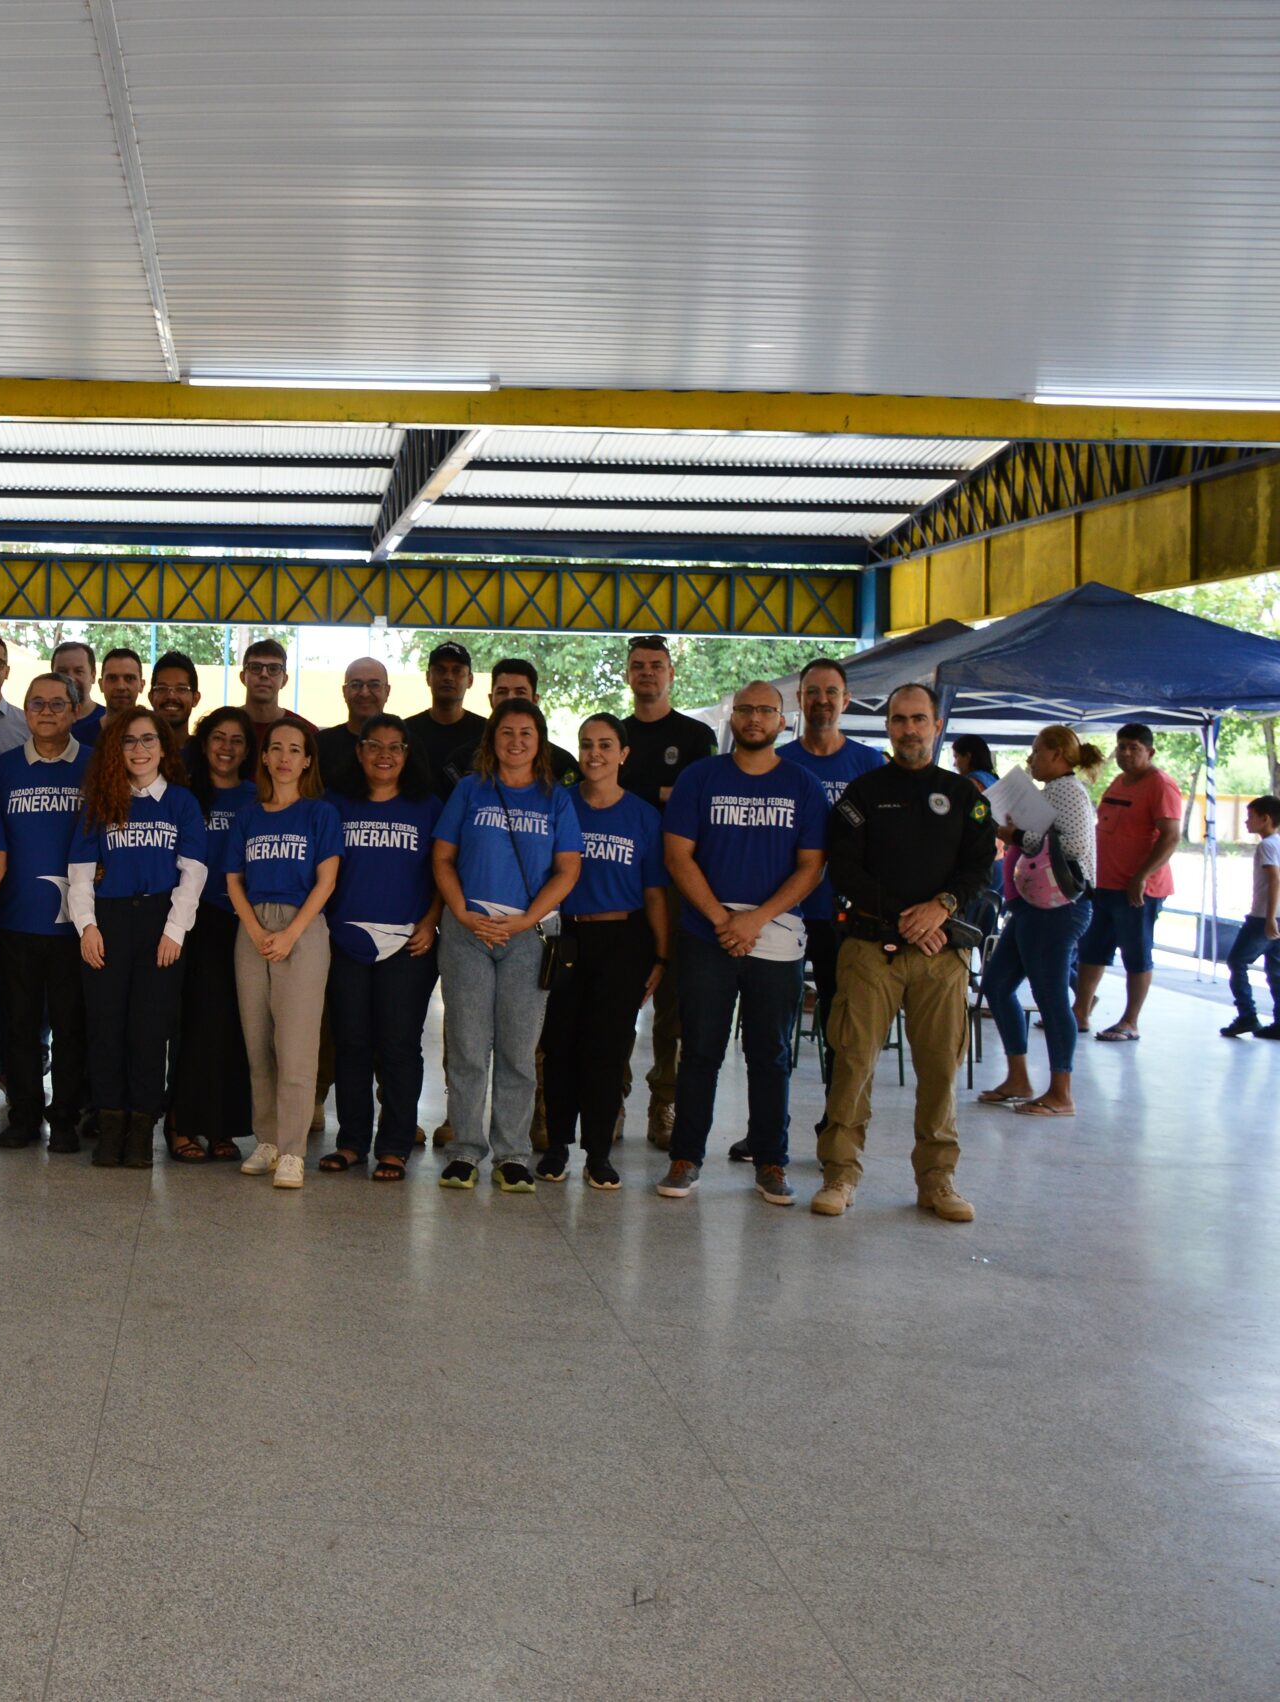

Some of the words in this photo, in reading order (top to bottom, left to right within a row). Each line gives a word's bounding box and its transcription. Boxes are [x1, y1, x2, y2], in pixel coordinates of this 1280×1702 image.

[10, 787, 34, 798] JUIZADO
[35, 787, 61, 795] ESPECIAL
[712, 796, 738, 805] JUIZADO
[767, 797, 796, 809] FEDERAL
[711, 805, 795, 828] ITINERANTE
[129, 821, 154, 830] ESPECIAL
[155, 821, 178, 833] FEDERAL
[360, 821, 390, 830] ESPECIAL
[391, 822, 419, 834] FEDERAL
[106, 829, 178, 851] ITINERANTE
[256, 835, 280, 844] ESPECIAL
[282, 834, 308, 843] FEDERAL
[344, 829, 419, 851] INERANTE
[609, 834, 635, 848] FEDERAL
